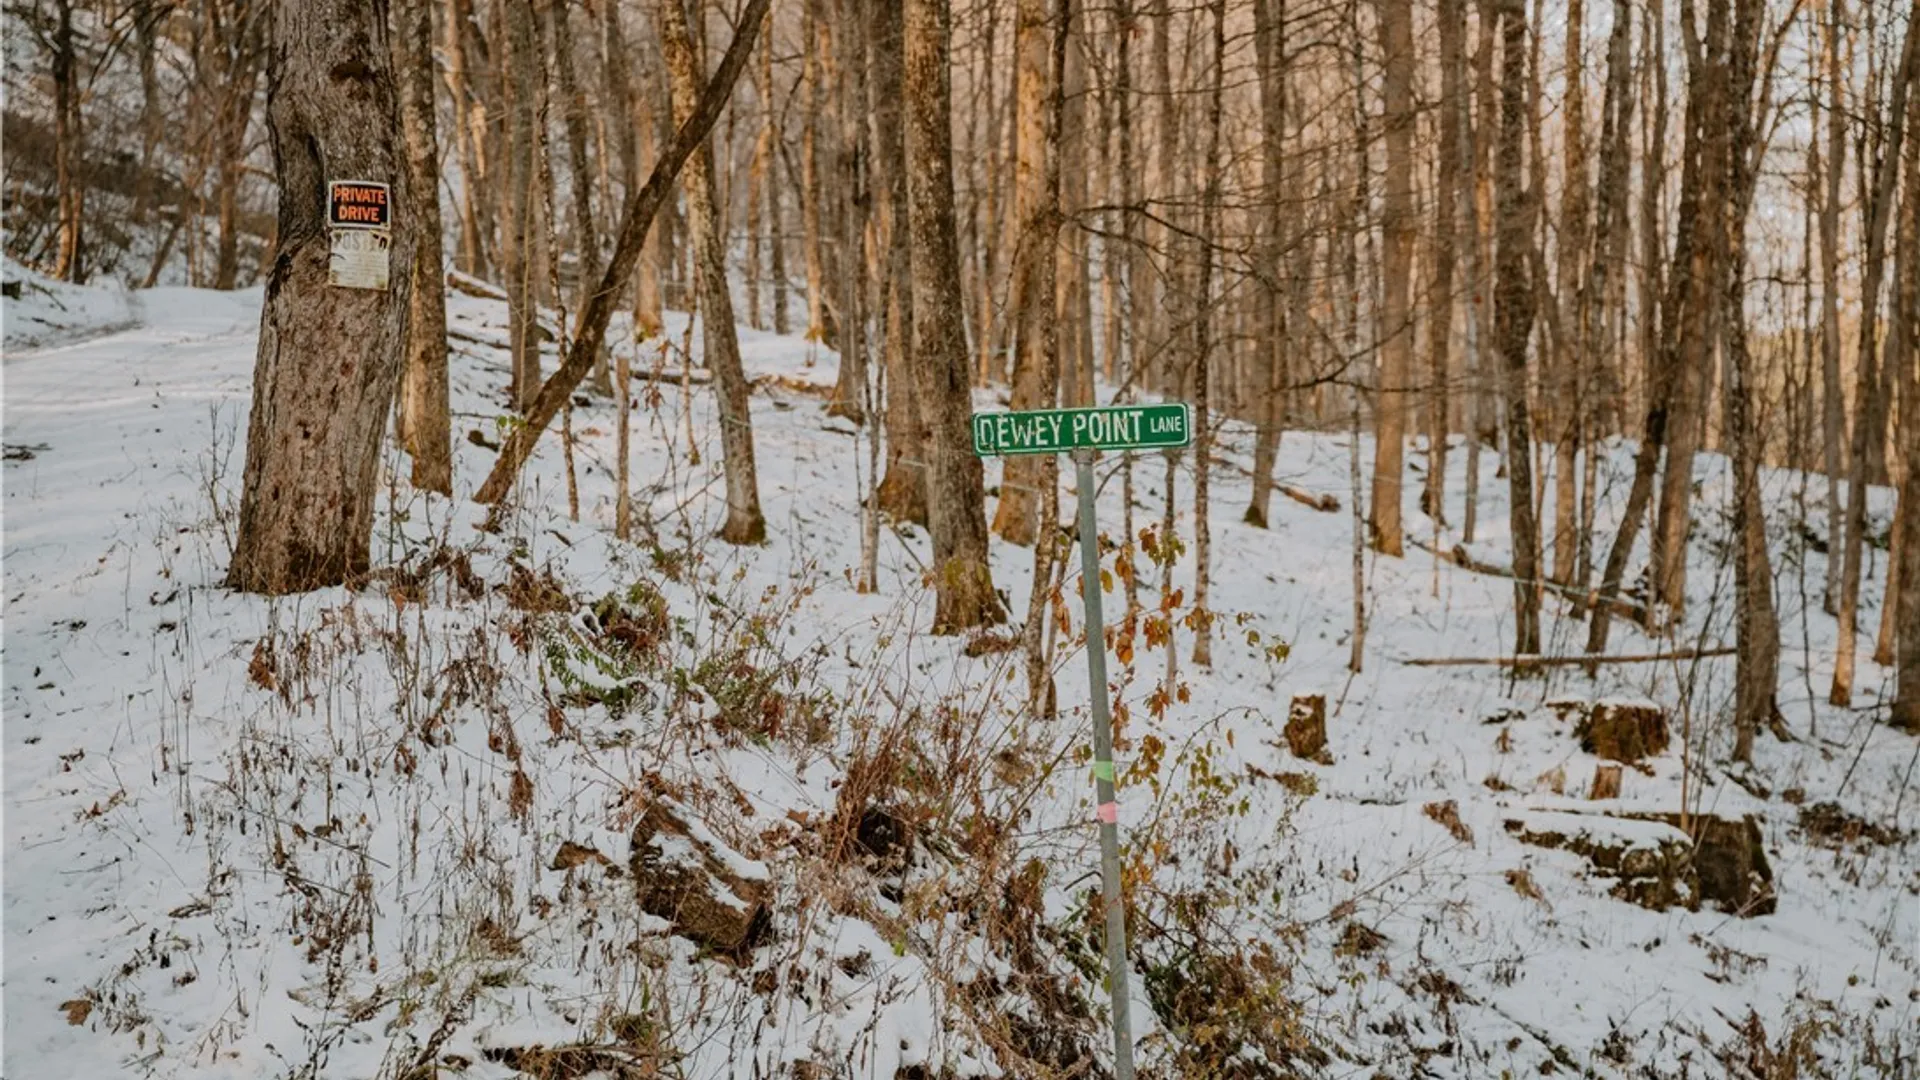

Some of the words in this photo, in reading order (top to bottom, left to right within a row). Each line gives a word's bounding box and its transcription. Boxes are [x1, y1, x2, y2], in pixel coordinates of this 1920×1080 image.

[334, 186, 386, 204] PRIVATE
[338, 205, 380, 222] DRIVE
[979, 413, 1063, 447] DEWEY
[1072, 410, 1144, 444] POINT
[1150, 415, 1183, 433] LANE
